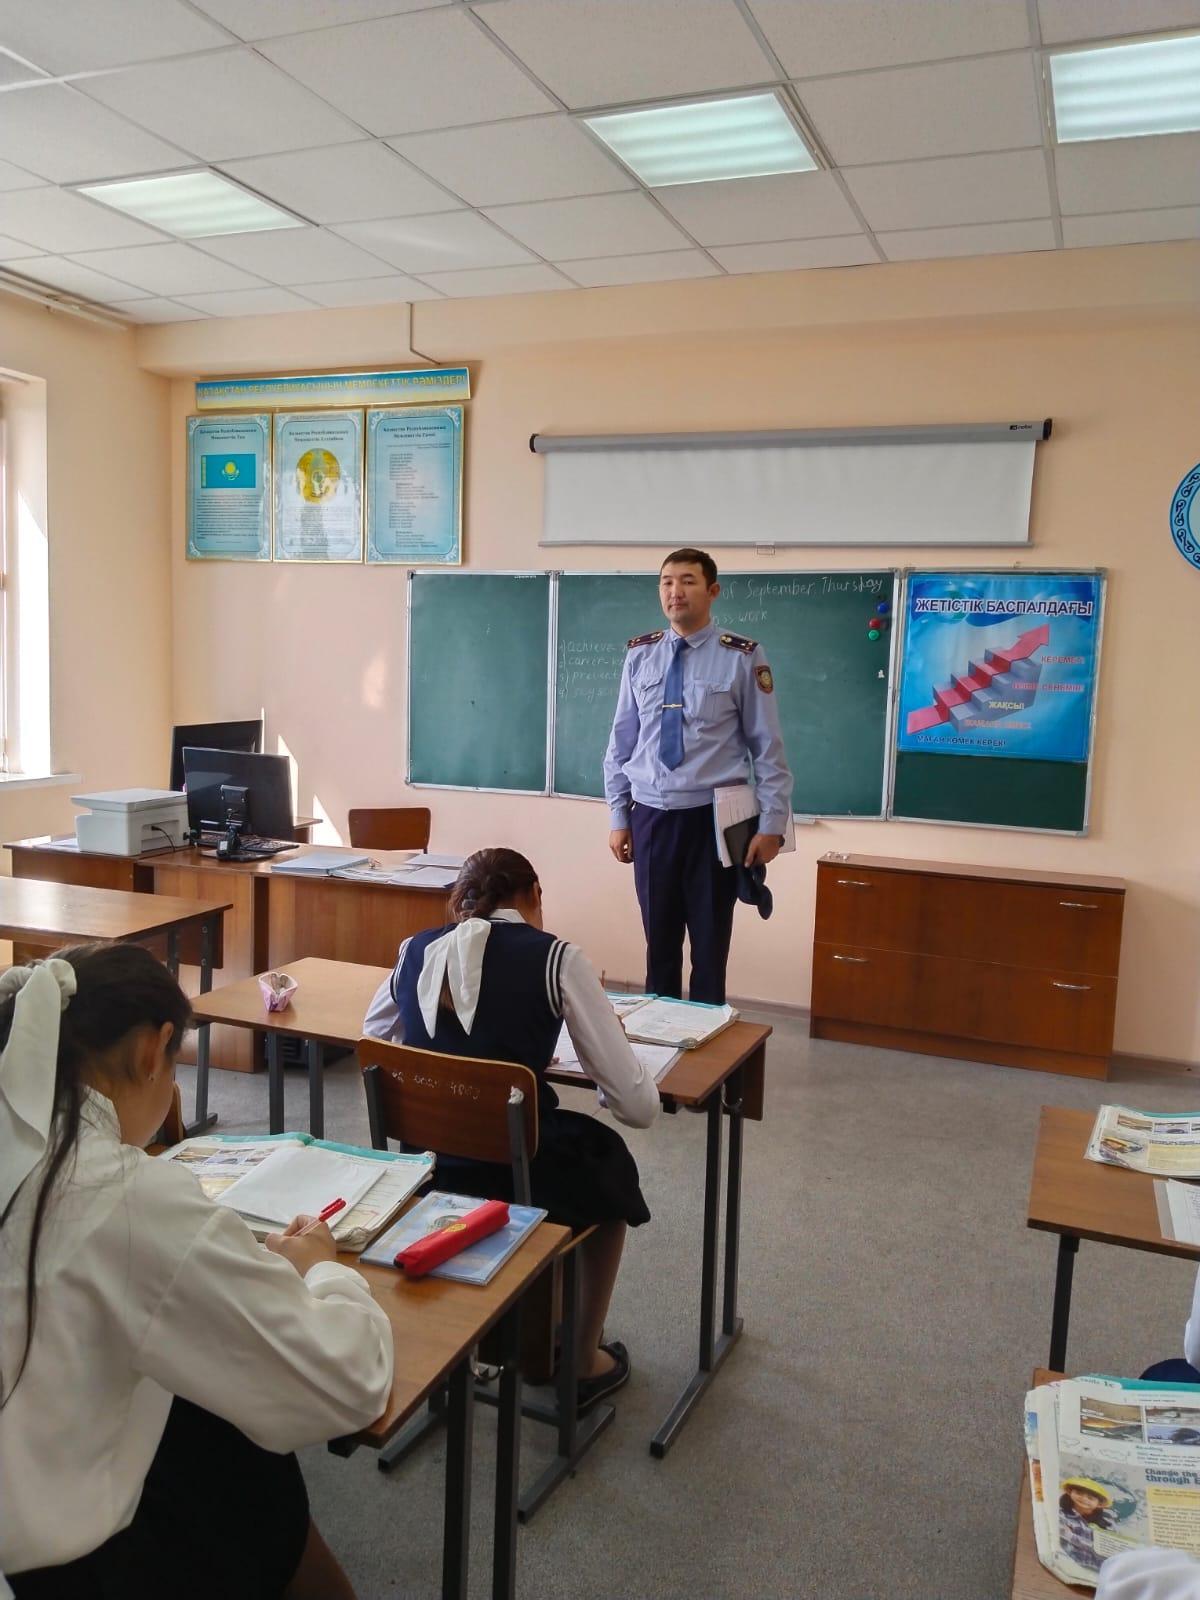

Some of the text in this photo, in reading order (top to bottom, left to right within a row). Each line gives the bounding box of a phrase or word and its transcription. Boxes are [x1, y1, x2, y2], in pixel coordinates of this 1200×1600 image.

[722, 580, 738, 600] of
[915, 597, 1093, 616] ЖЕТІСТІК БАСПАЛДАҒЫ
[988, 701, 1025, 711] ЖАҚСЫ!
[976, 738, 1006, 747] КЕРЕК!
[1145, 1475, 1190, 1485] through
